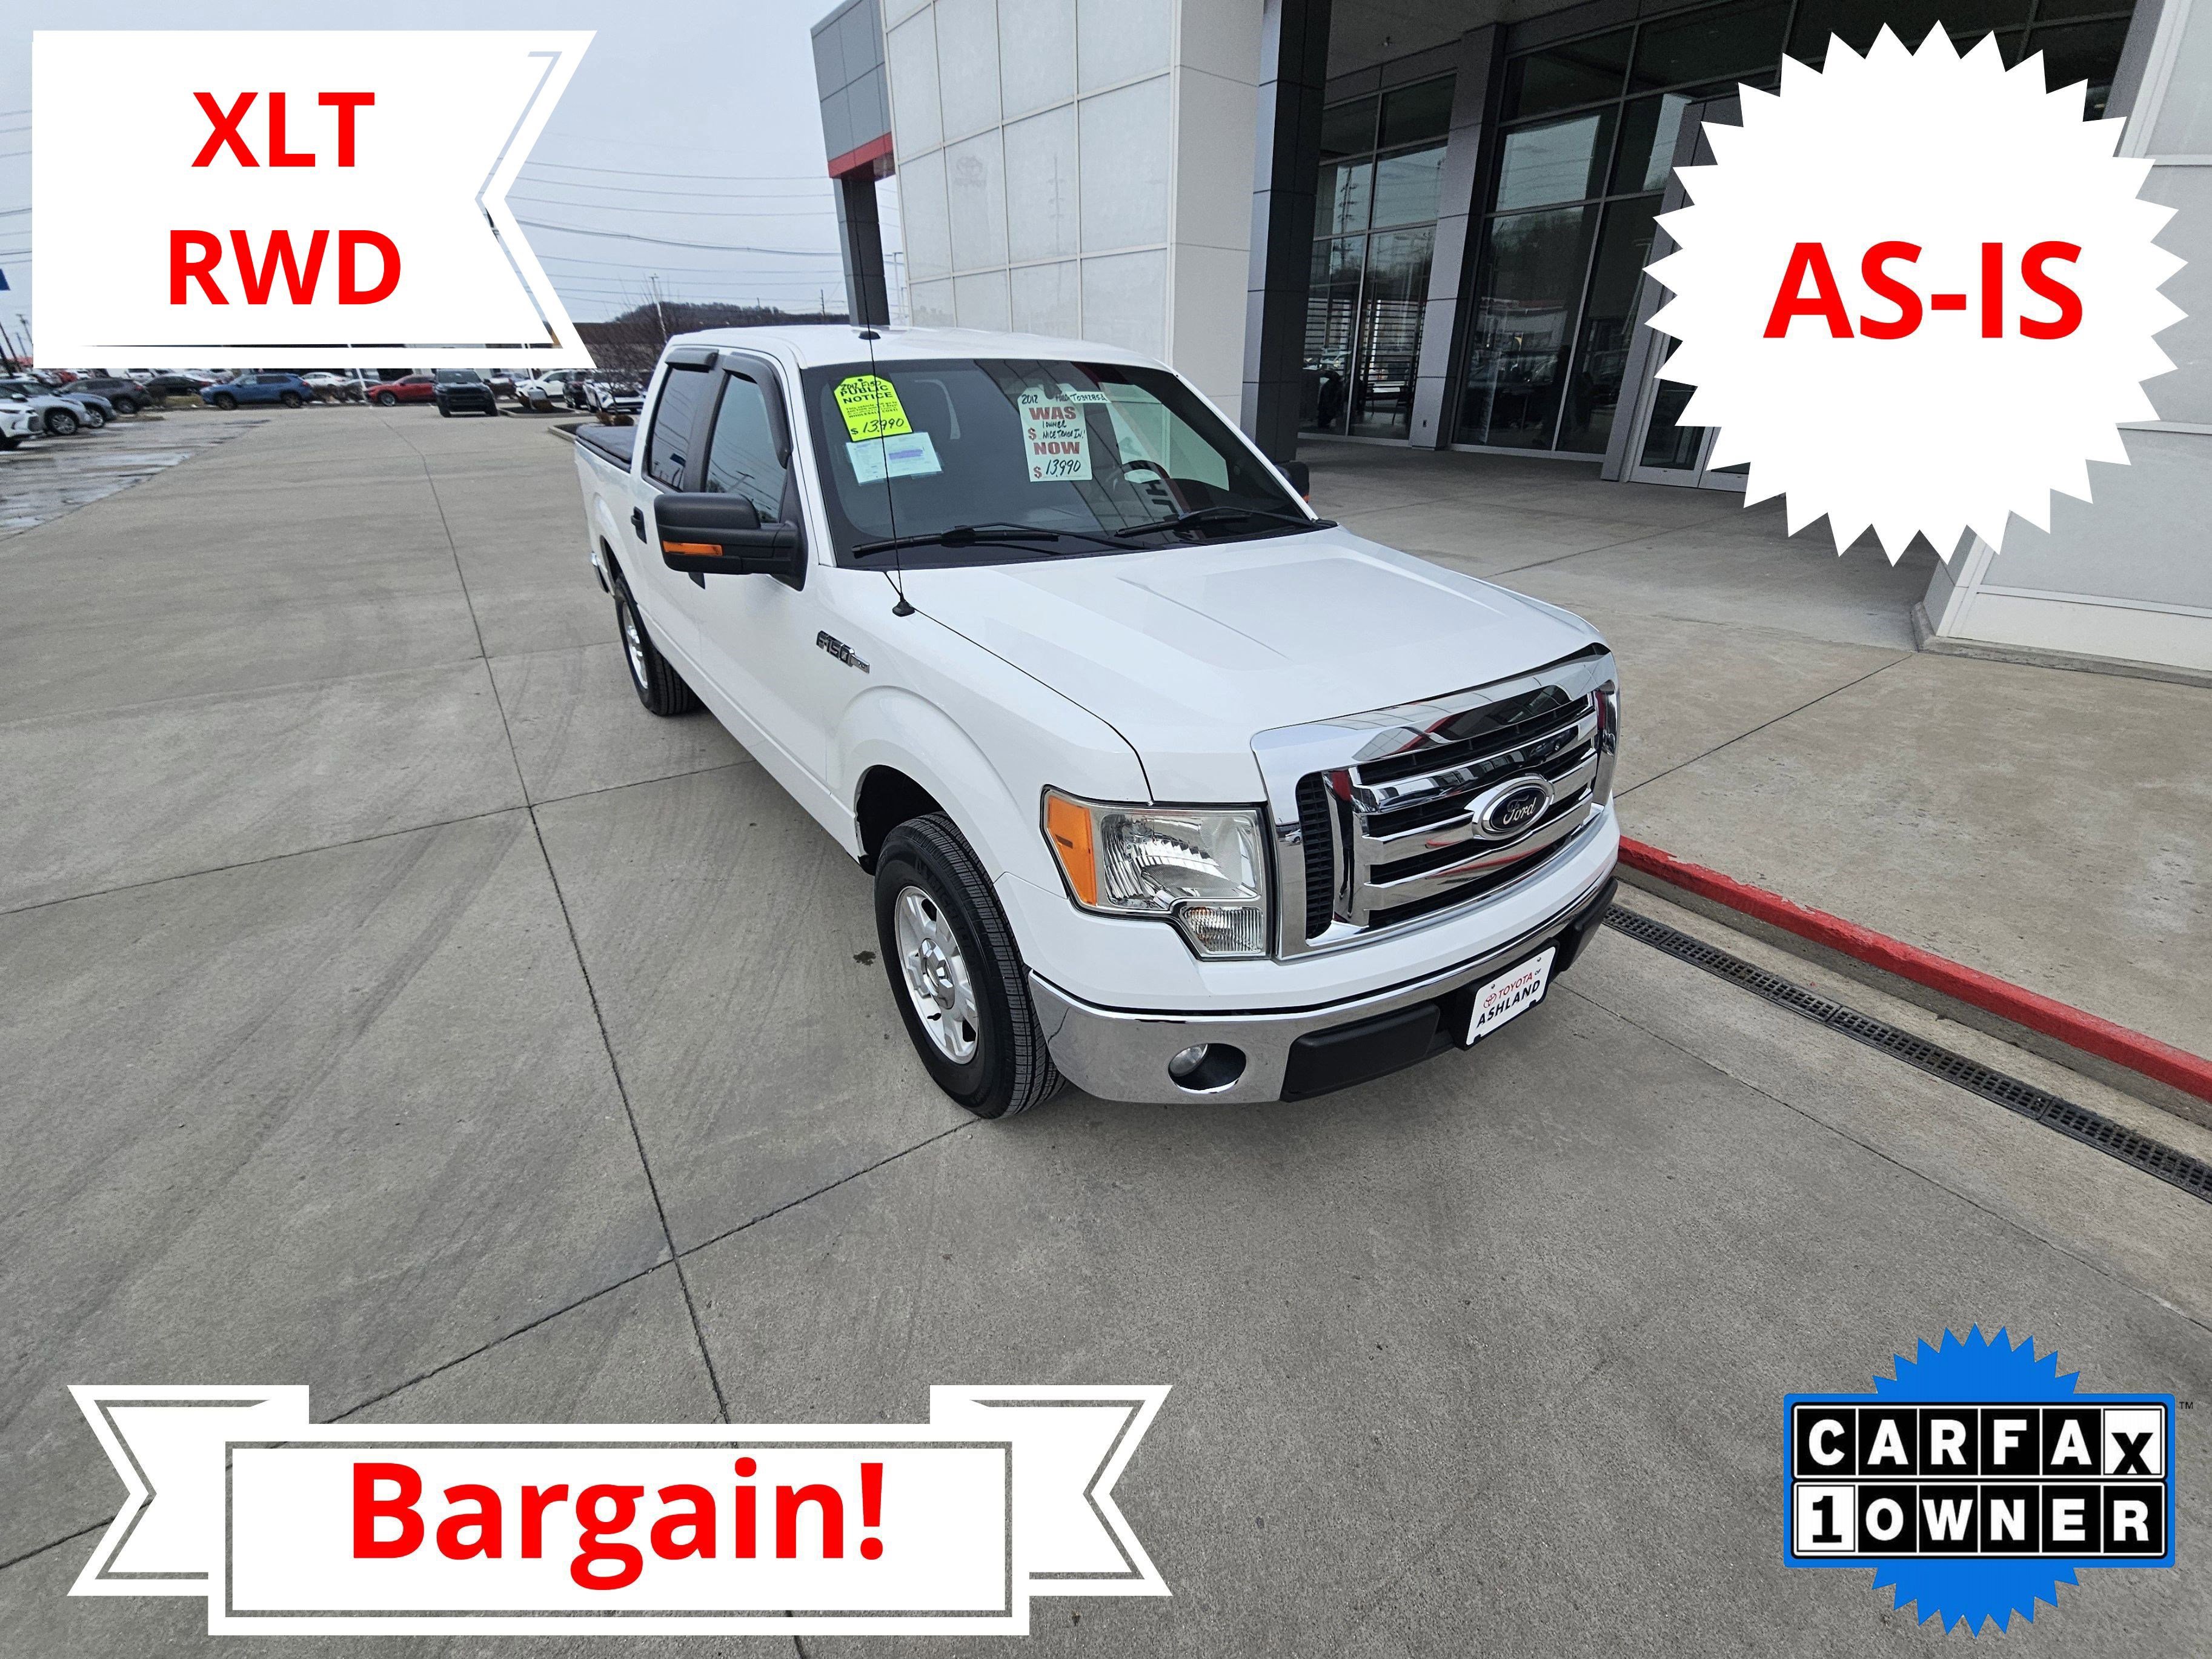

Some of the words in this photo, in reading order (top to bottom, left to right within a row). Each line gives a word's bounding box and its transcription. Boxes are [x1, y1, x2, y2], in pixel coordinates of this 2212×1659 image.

[840, 385, 889, 396] PUBLIC
[843, 392, 893, 404] NOTICE
[1021, 394, 1038, 404] 2012
[1029, 407, 1077, 421] WAS
[1028, 427, 1037, 441] $
[1033, 441, 1080, 456] NOW
[1033, 466, 1042, 479] $
[1503, 794, 1537, 825] Ford
[1498, 972, 1534, 999] TOYOTA
[1476, 979, 1541, 1029] ASHLAND
